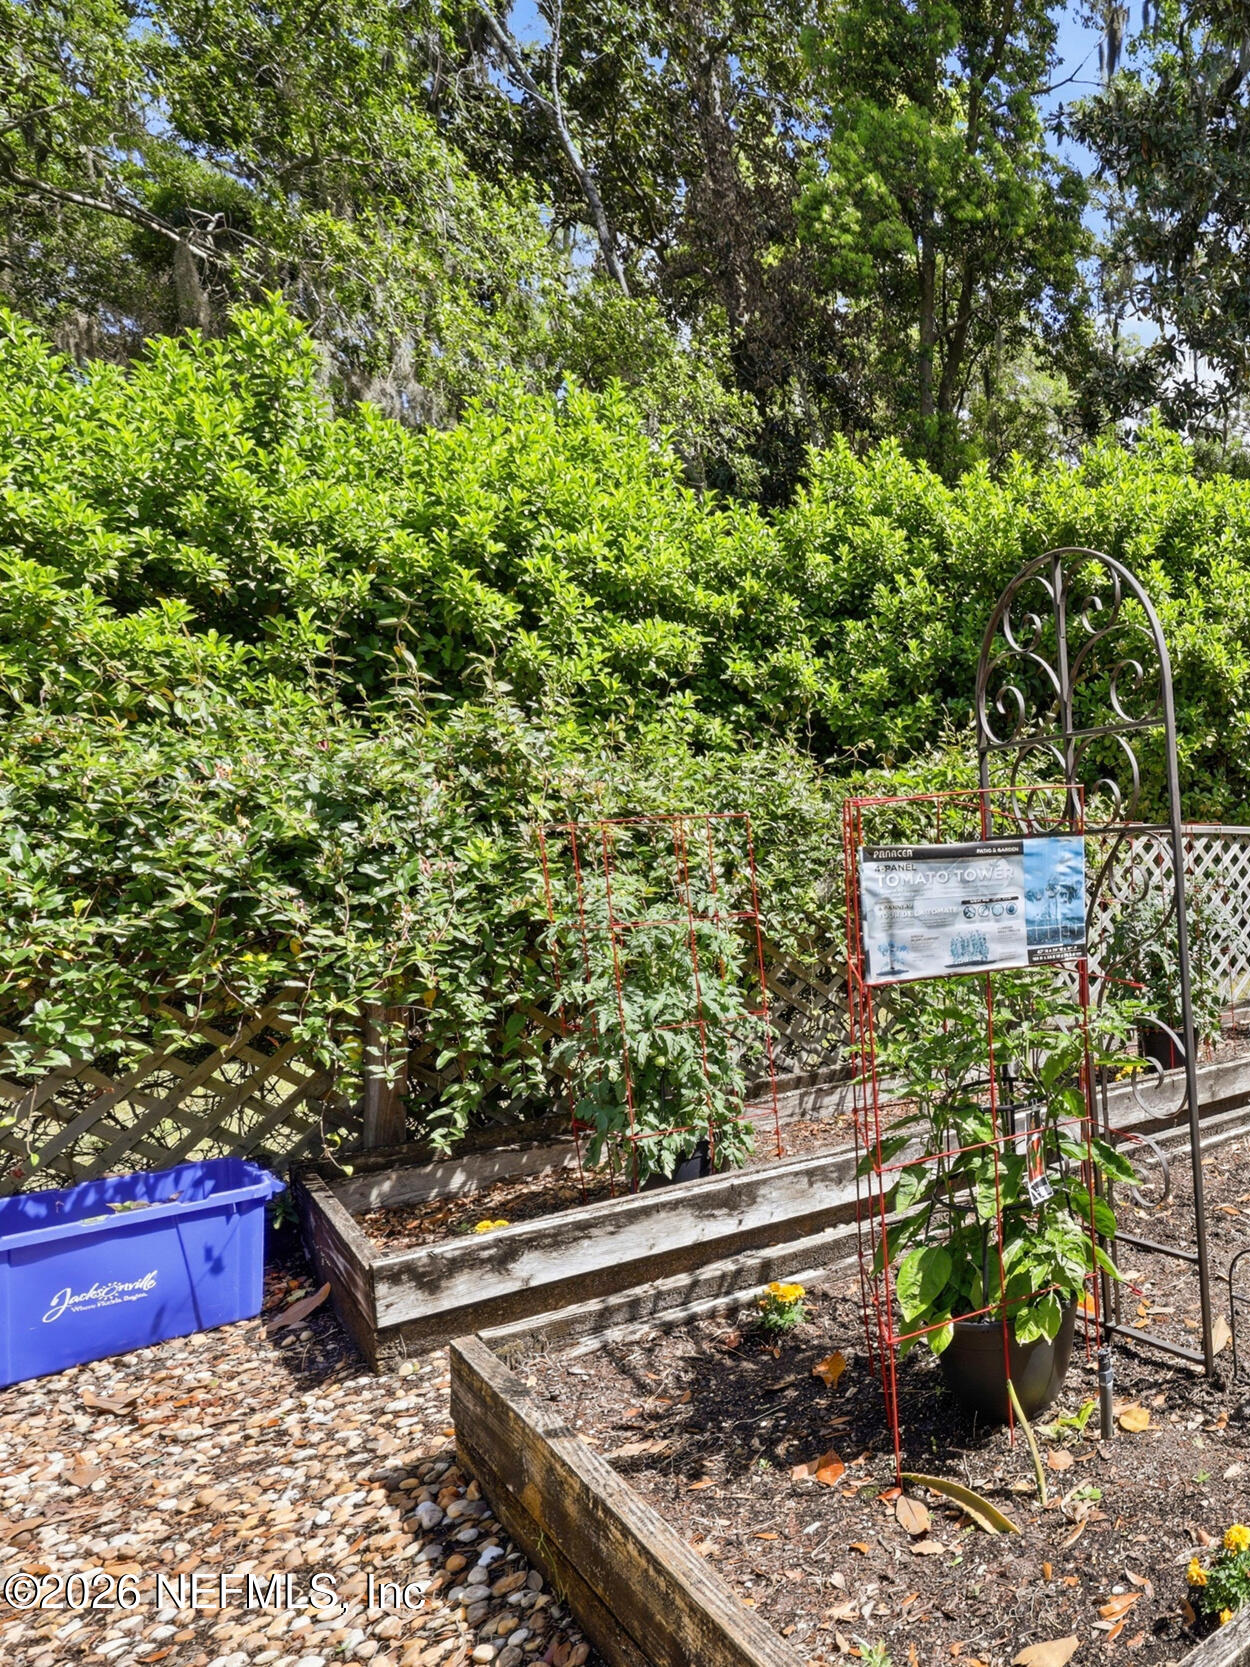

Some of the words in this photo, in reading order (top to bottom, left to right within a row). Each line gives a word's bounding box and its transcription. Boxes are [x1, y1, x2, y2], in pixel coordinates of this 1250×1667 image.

[873, 848, 914, 859] PANACEA
[874, 863, 917, 873] 4-PANEL
[876, 870, 949, 888] TOMATO
[954, 866, 1016, 882] TOWER
[42, 1269, 158, 1323] Jacksonville
